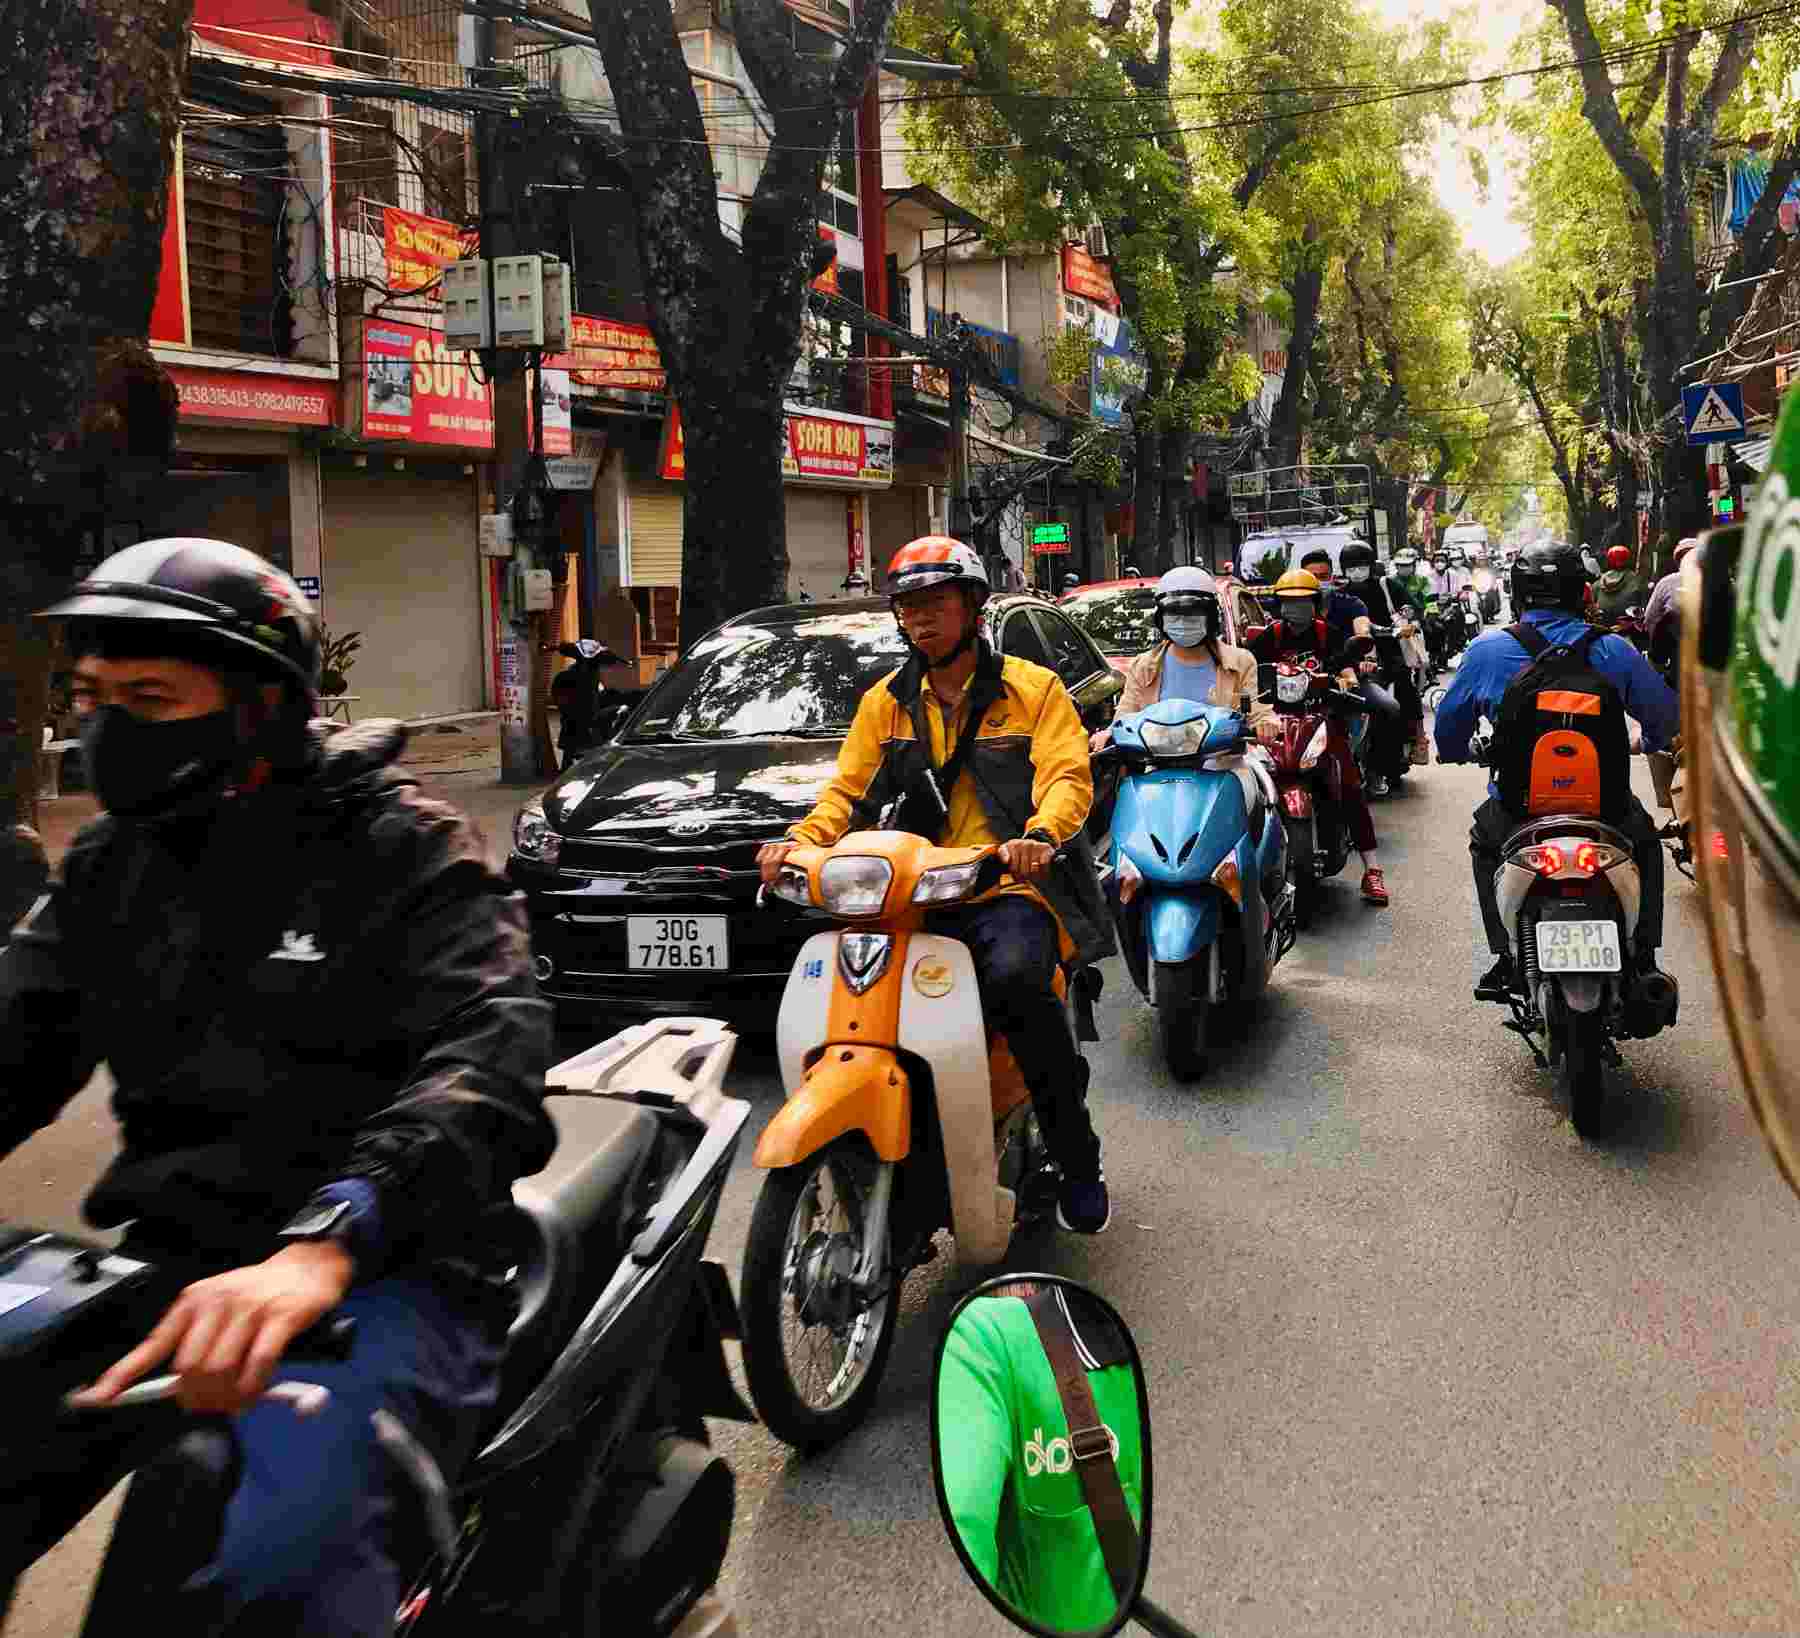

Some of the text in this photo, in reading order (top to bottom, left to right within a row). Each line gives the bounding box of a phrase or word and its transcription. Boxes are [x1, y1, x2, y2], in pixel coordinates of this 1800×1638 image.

[797, 420, 833, 454] SOFA
[656, 919, 699, 941] 30G
[638, 944, 715, 967] 778.61
